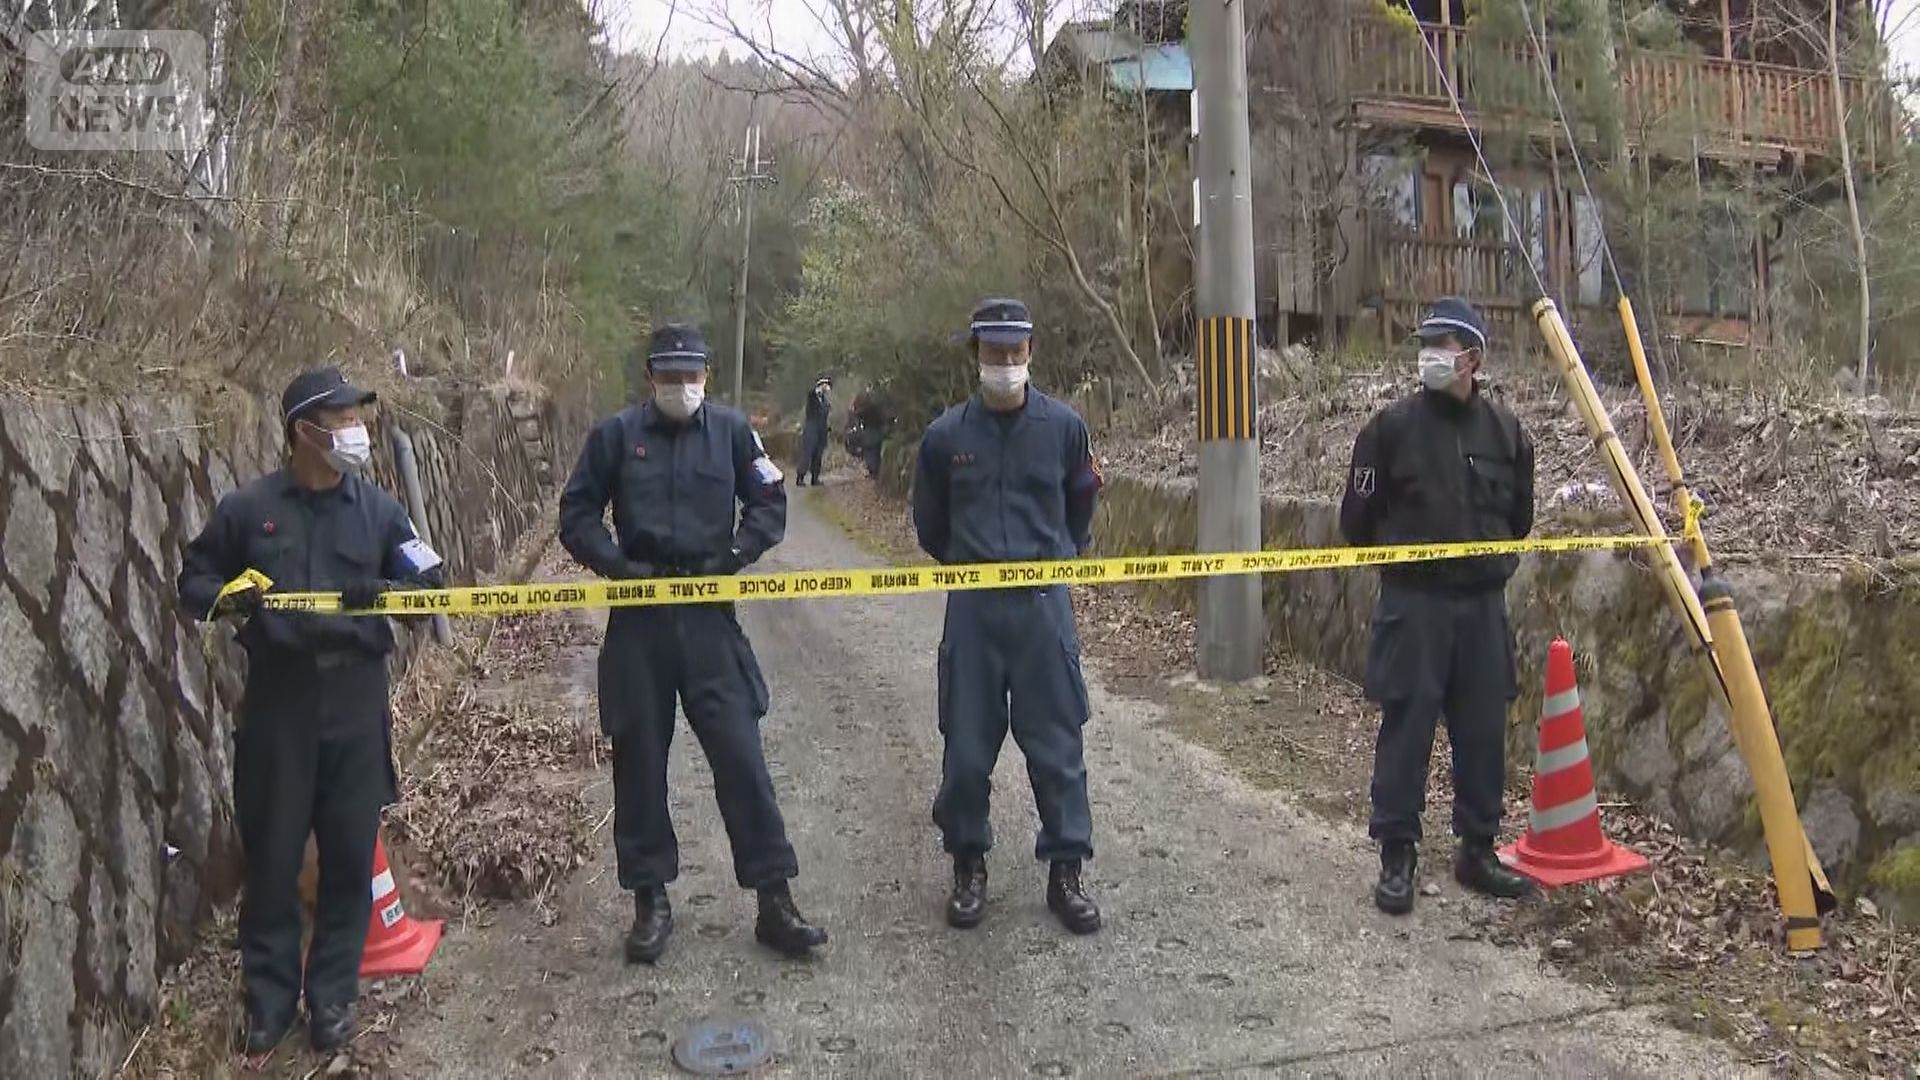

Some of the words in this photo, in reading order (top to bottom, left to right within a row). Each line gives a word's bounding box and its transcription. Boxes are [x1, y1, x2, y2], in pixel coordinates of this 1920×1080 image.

[1181, 558, 1225, 572] 立入禁止
[1242, 556, 1284, 569] POLICE
[1289, 554, 1311, 567] OUT
[1312, 553, 1341, 565] KEEP
[932, 570, 980, 584] 立入禁止
[1000, 566, 1043, 582] POLICE
[1051, 566, 1074, 579] OUT
[1075, 565, 1105, 577] KEEP
[669, 582, 719, 598] 立入禁止
[739, 578, 786, 594] POLICE
[794, 578, 818, 592] OUT
[820, 577, 852, 590] KEEP
[401, 593, 450, 608] 立入禁止
[471, 591, 518, 605] POLICE
[527, 590, 551, 604] OUT
[554, 588, 586, 602] KEEP
[263, 598, 280, 610] OU
[284, 597, 316, 610] KEEP
